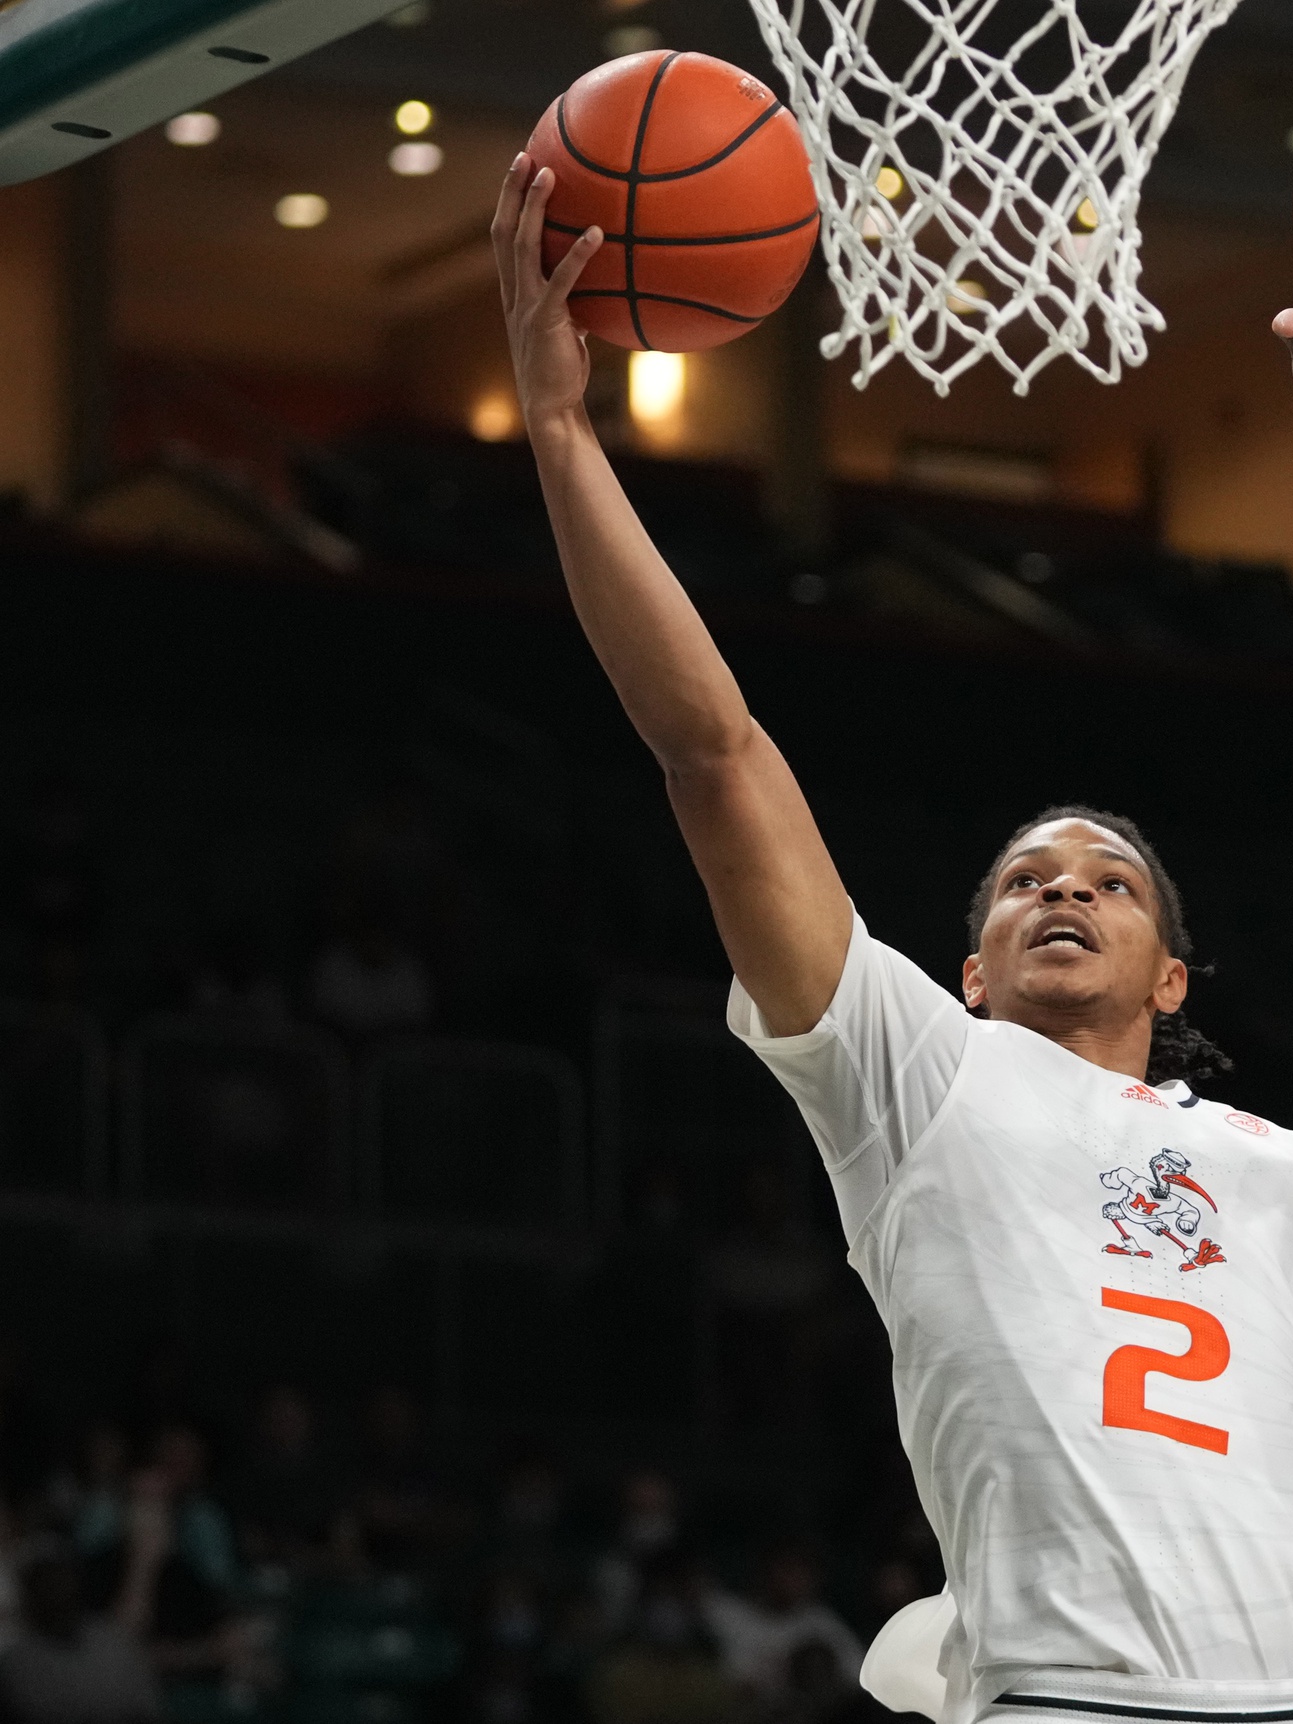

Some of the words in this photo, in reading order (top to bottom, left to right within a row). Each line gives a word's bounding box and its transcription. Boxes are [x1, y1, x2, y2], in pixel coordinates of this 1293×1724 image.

[1120, 1091, 1169, 1109] adidas
[1129, 1192, 1160, 1215] M
[1101, 1286, 1231, 1456] 2
